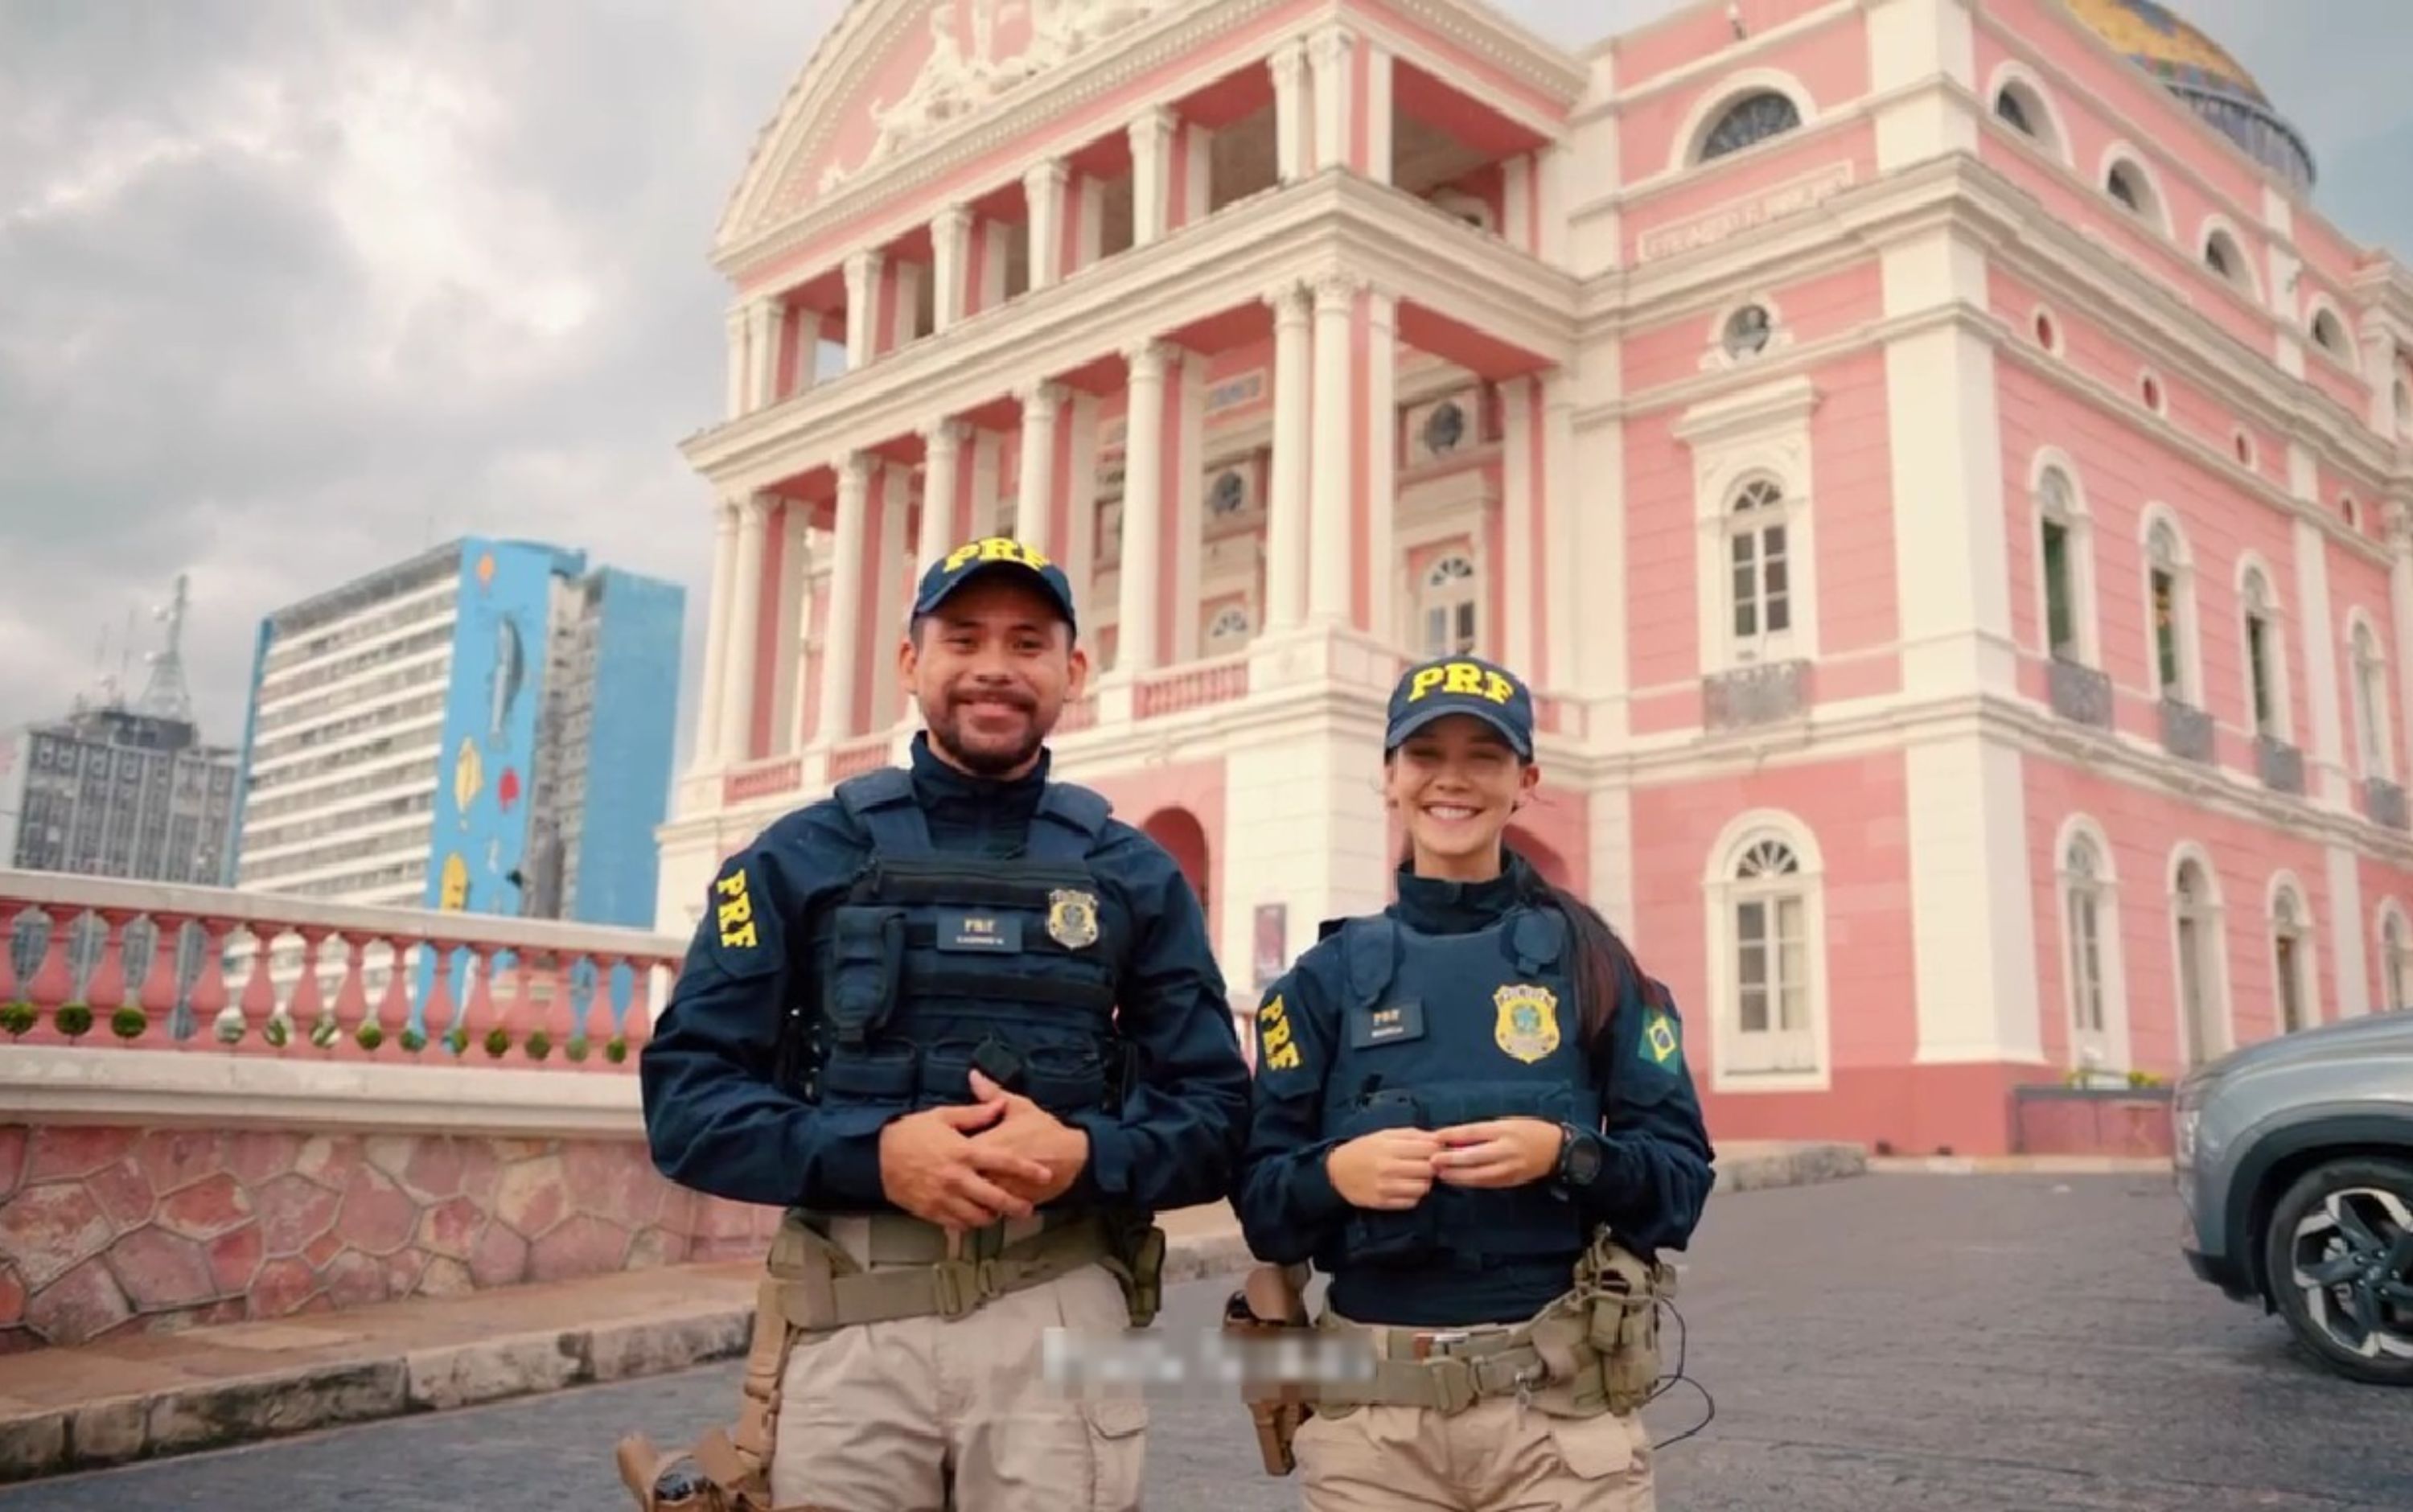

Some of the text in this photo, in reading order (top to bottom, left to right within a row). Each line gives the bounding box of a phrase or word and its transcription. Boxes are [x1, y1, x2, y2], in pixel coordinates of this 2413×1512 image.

[943, 537, 1049, 572] PRF
[1408, 662, 1515, 705] PRF
[717, 869, 758, 947] PRF
[1260, 993, 1301, 1071] PRF
